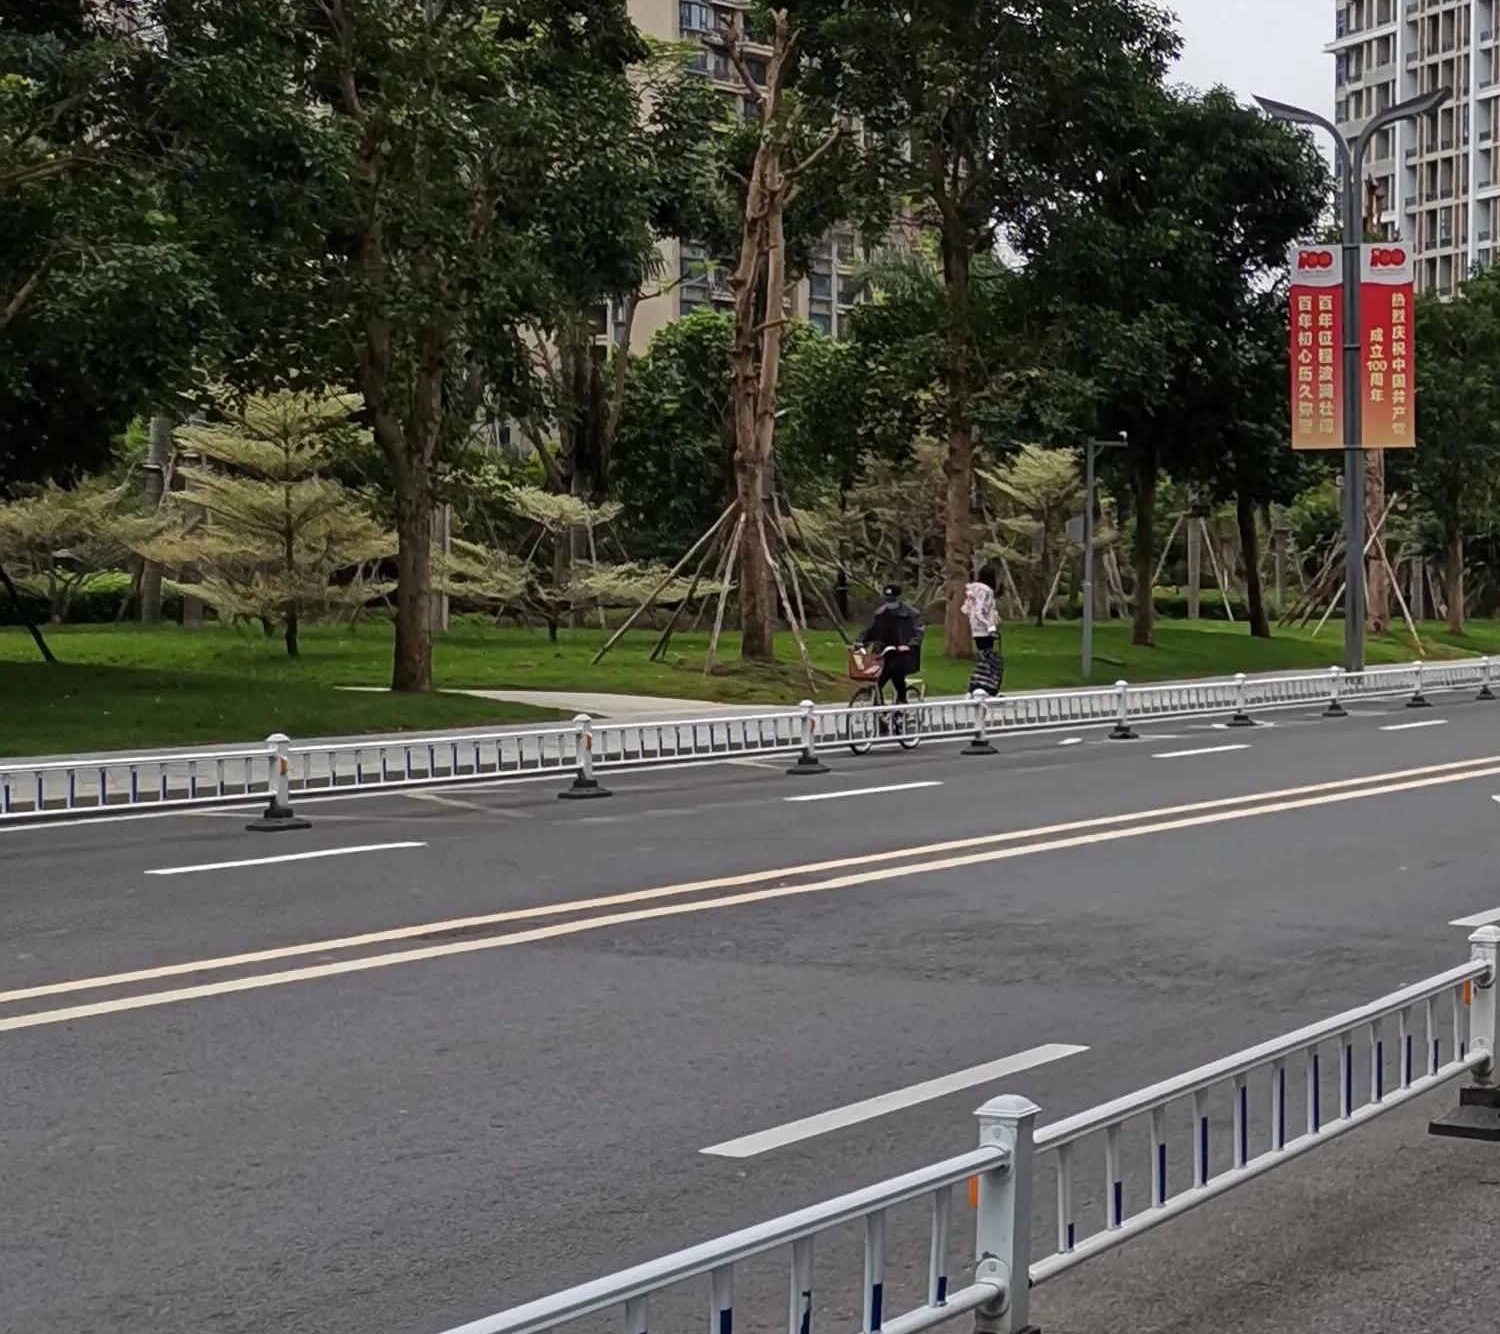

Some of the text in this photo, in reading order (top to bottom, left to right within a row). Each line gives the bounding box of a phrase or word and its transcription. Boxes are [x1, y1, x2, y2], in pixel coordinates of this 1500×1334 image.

[1366, 328, 1388, 403] 成立100周年
[1392, 292, 1406, 436] 热烈庆祝中国共产党
